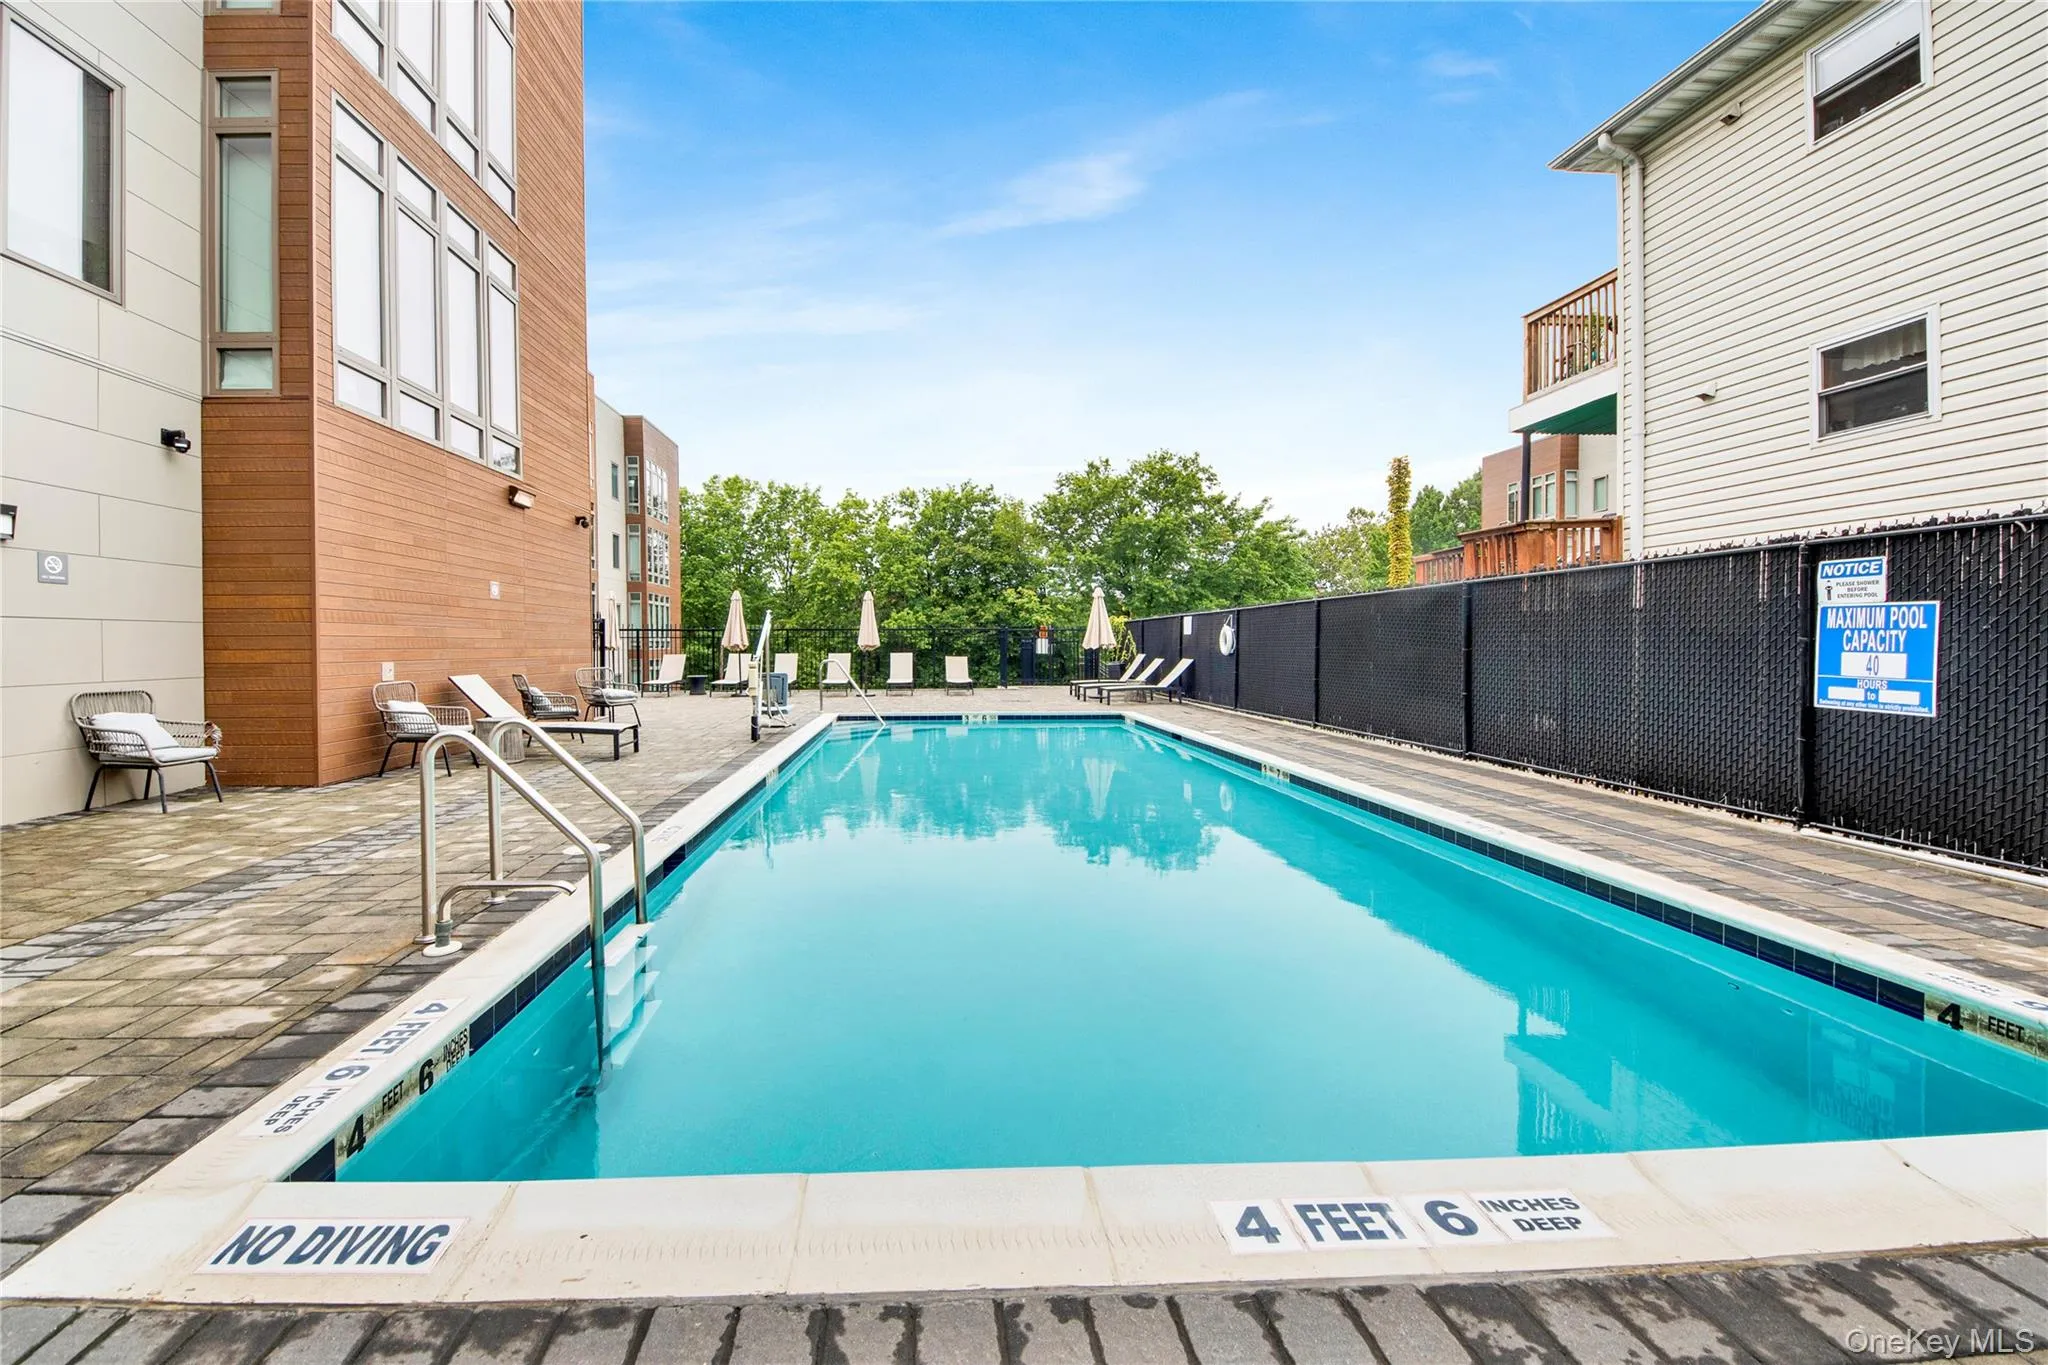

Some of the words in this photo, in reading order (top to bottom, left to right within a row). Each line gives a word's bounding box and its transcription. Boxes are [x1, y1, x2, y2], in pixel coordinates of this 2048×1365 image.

[1822, 561, 1881, 577] NOTICE
[1827, 607, 1885, 629] MAXIMUM
[1889, 607, 1928, 629] POOL
[1843, 630, 1907, 652] CAPACITY
[1866, 655, 1879, 676] 40
[1857, 680, 1888, 689] HOURS
[1867, 691, 1876, 700] to
[414, 1002, 448, 1014] 4
[1937, 1003, 1964, 1031] 4
[1988, 1016, 2025, 1043] FEET
[360, 1022, 430, 1054] FEET
[446, 1047, 465, 1073] DEEP
[325, 1065, 370, 1080] 6
[346, 1114, 367, 1158] 4
[382, 1080, 404, 1115] FEET
[419, 1058, 435, 1095] 6
[443, 1028, 468, 1063] INCHES
[264, 1096, 312, 1126] DEEP
[273, 1088, 341, 1133] INCHES
[1235, 1206, 1282, 1243] 4
[1293, 1202, 1408, 1242] FEET
[1424, 1200, 1479, 1236] 6
[1479, 1197, 1581, 1213] INCHES
[1512, 1215, 1583, 1232] DEEP
[210, 1225, 296, 1265] NO
[283, 1224, 451, 1265] DIVING
